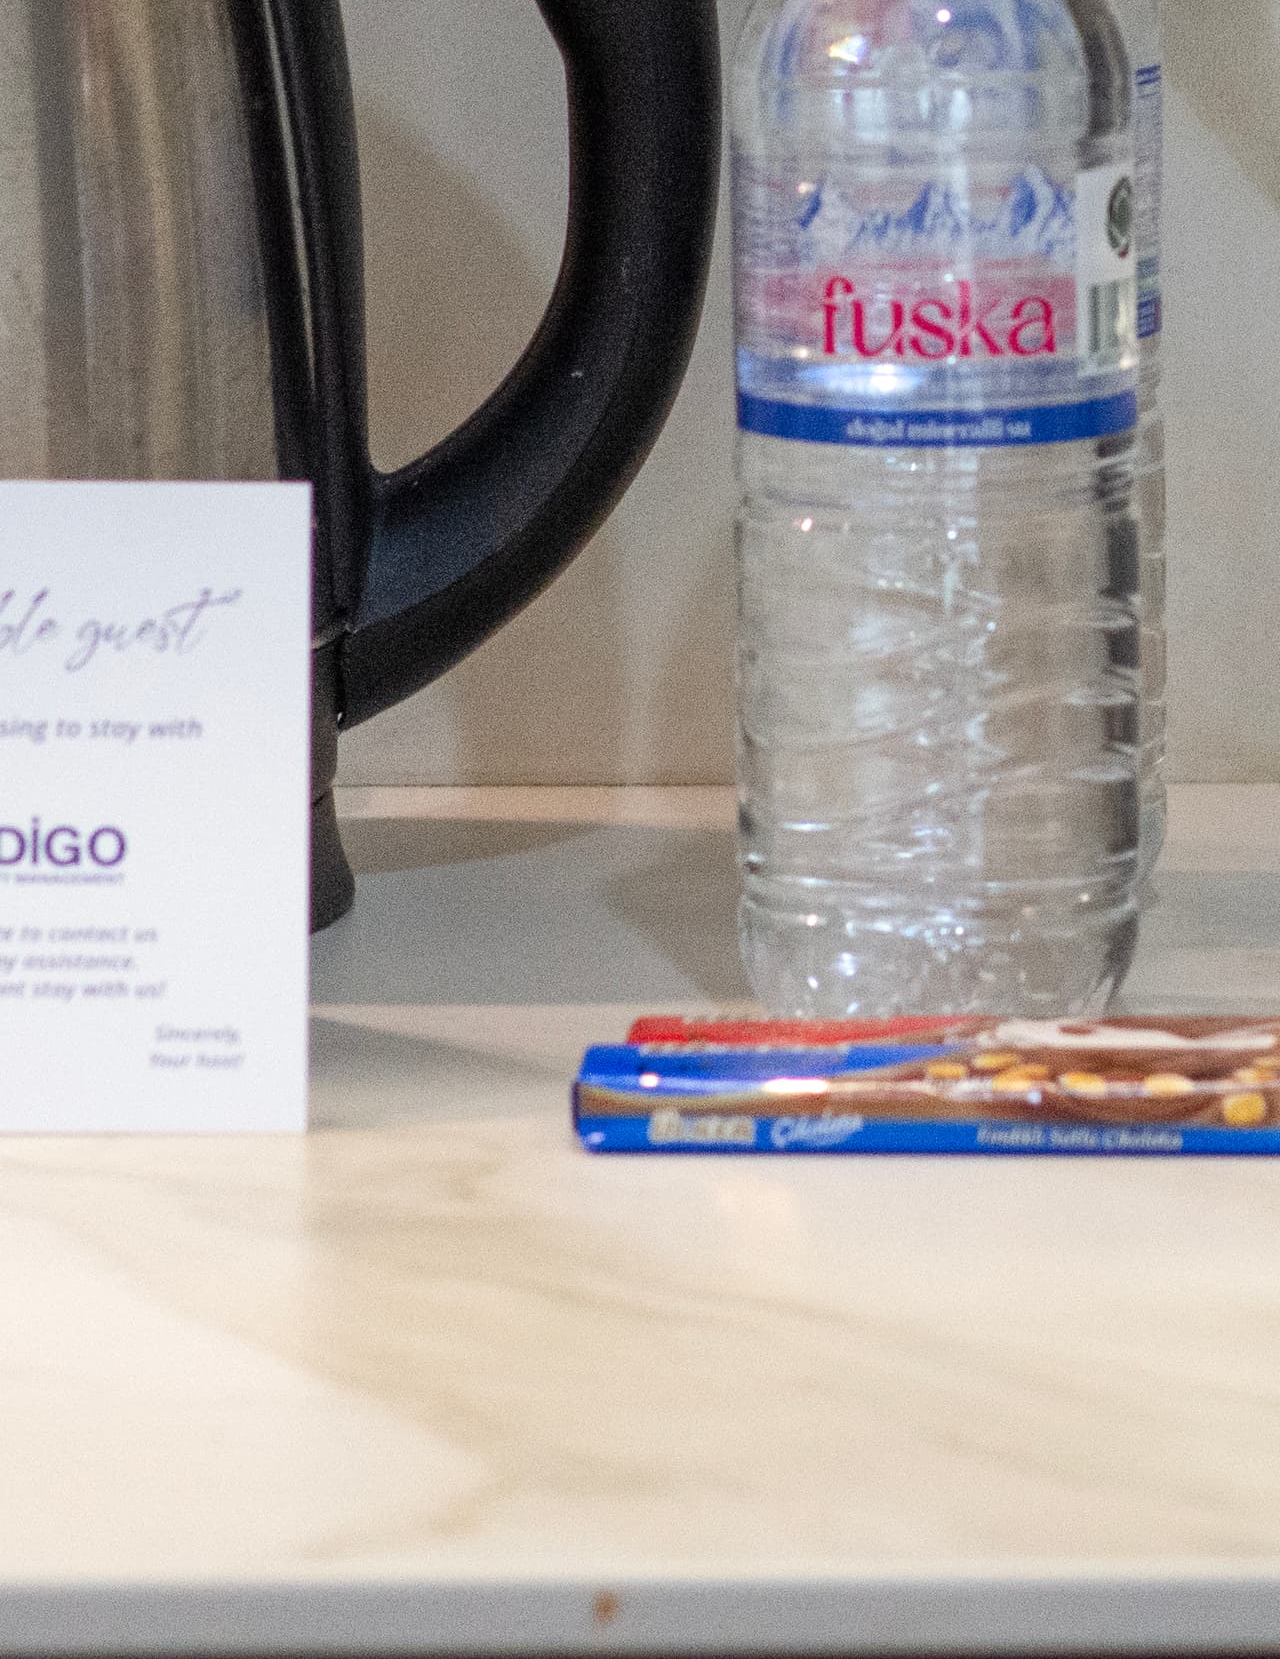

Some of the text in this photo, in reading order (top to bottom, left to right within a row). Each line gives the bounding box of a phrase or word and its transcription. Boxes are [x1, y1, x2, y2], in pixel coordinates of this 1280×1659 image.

[821, 275, 1058, 360] fuska
[64, 587, 243, 673] guest
[54, 718, 83, 739] to
[89, 719, 143, 745] stay
[147, 717, 204, 740] with
[19, 925, 44, 942] to
[47, 926, 130, 943] contact
[134, 927, 159, 943] us
[31, 981, 77, 1002] stay
[81, 980, 130, 999] with
[149, 1052, 192, 1069] Your
